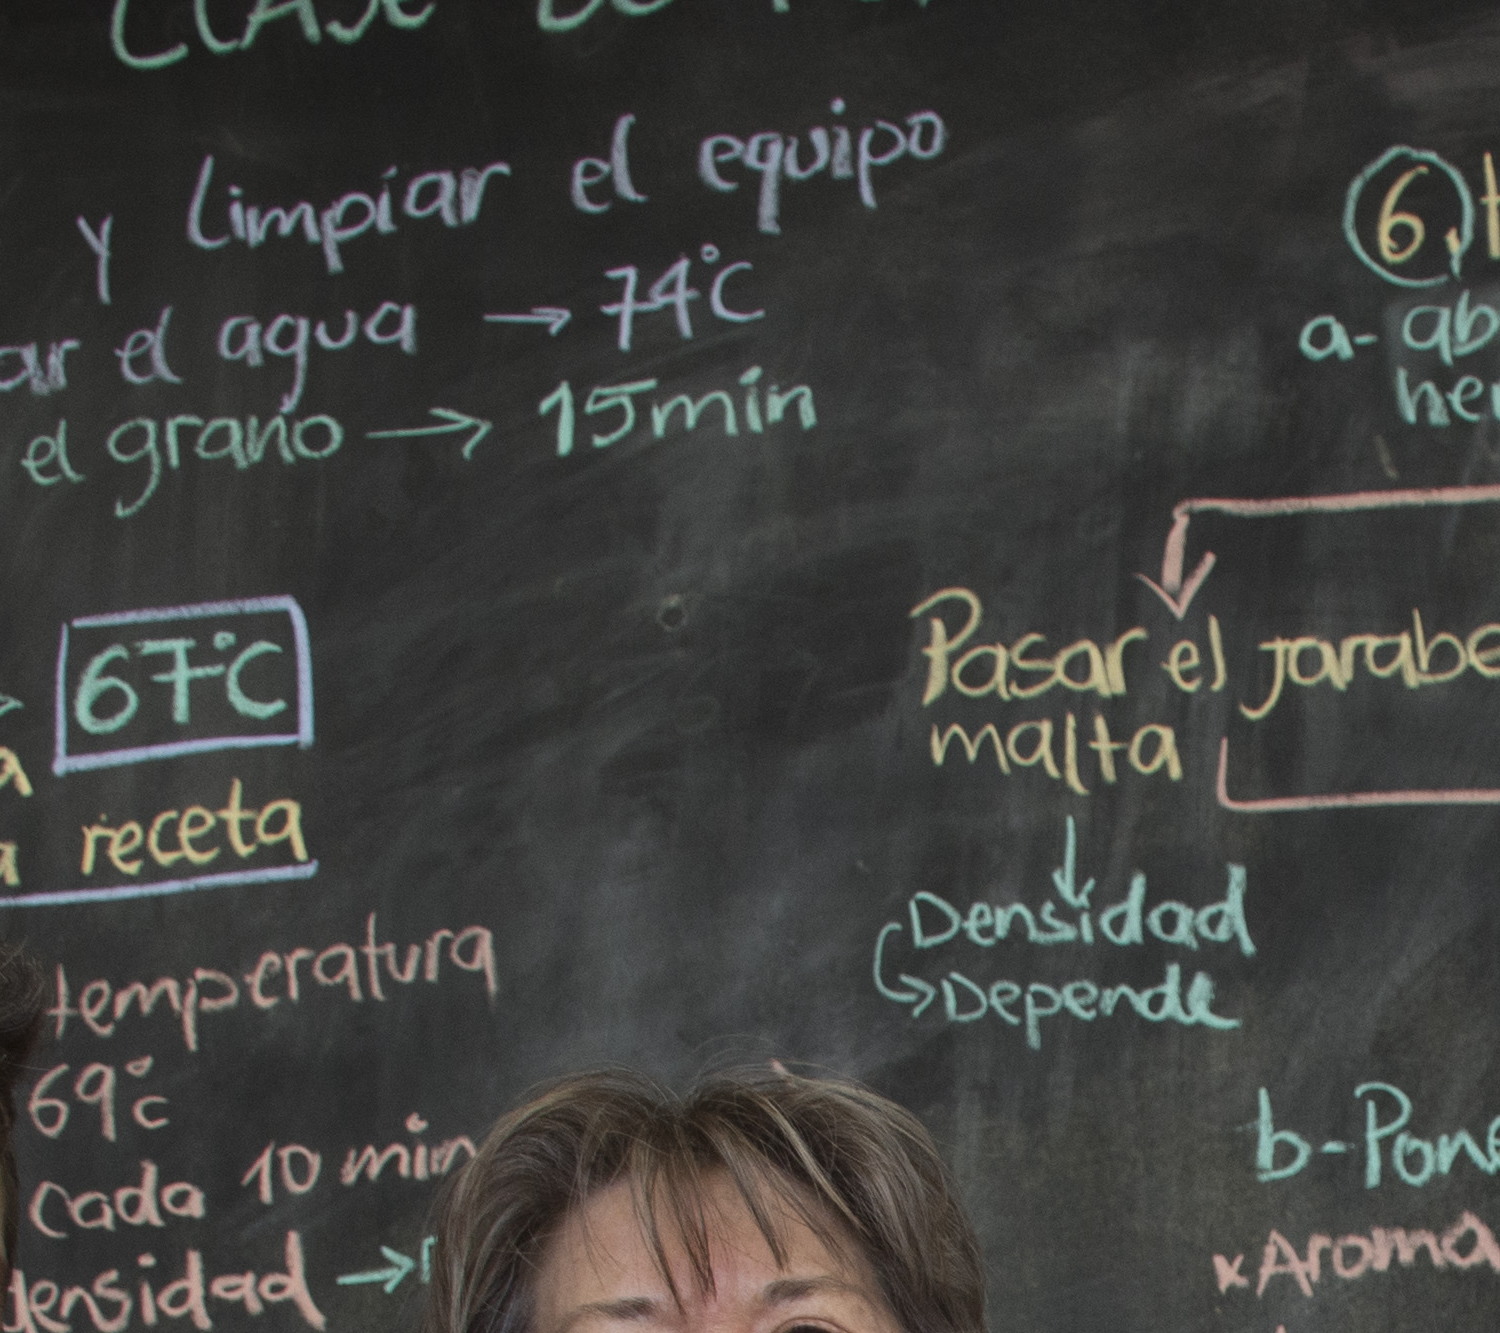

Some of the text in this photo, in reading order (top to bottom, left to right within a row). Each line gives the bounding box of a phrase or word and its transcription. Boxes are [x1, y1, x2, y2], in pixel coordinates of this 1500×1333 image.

[570, 112, 647, 214] el
[700, 96, 945, 232] equipo
[113, 306, 183, 387] el
[217, 298, 416, 411] agua
[600, 243, 767, 352] 74°C
[22, 417, 81, 488] el
[108, 403, 345, 518] grano
[76, 632, 287, 734] 67°C
[910, 587, 1147, 706] Pasar
[1164, 614, 1227, 694] el
[931, 711, 1182, 795] malta
[80, 779, 311, 877] receta
[910, 861, 1256, 957] Densidad
[48, 913, 499, 1051] temperatura
[941, 959, 1240, 1051] Depende
[29, 1112, 477, 1239] cada 10 min
